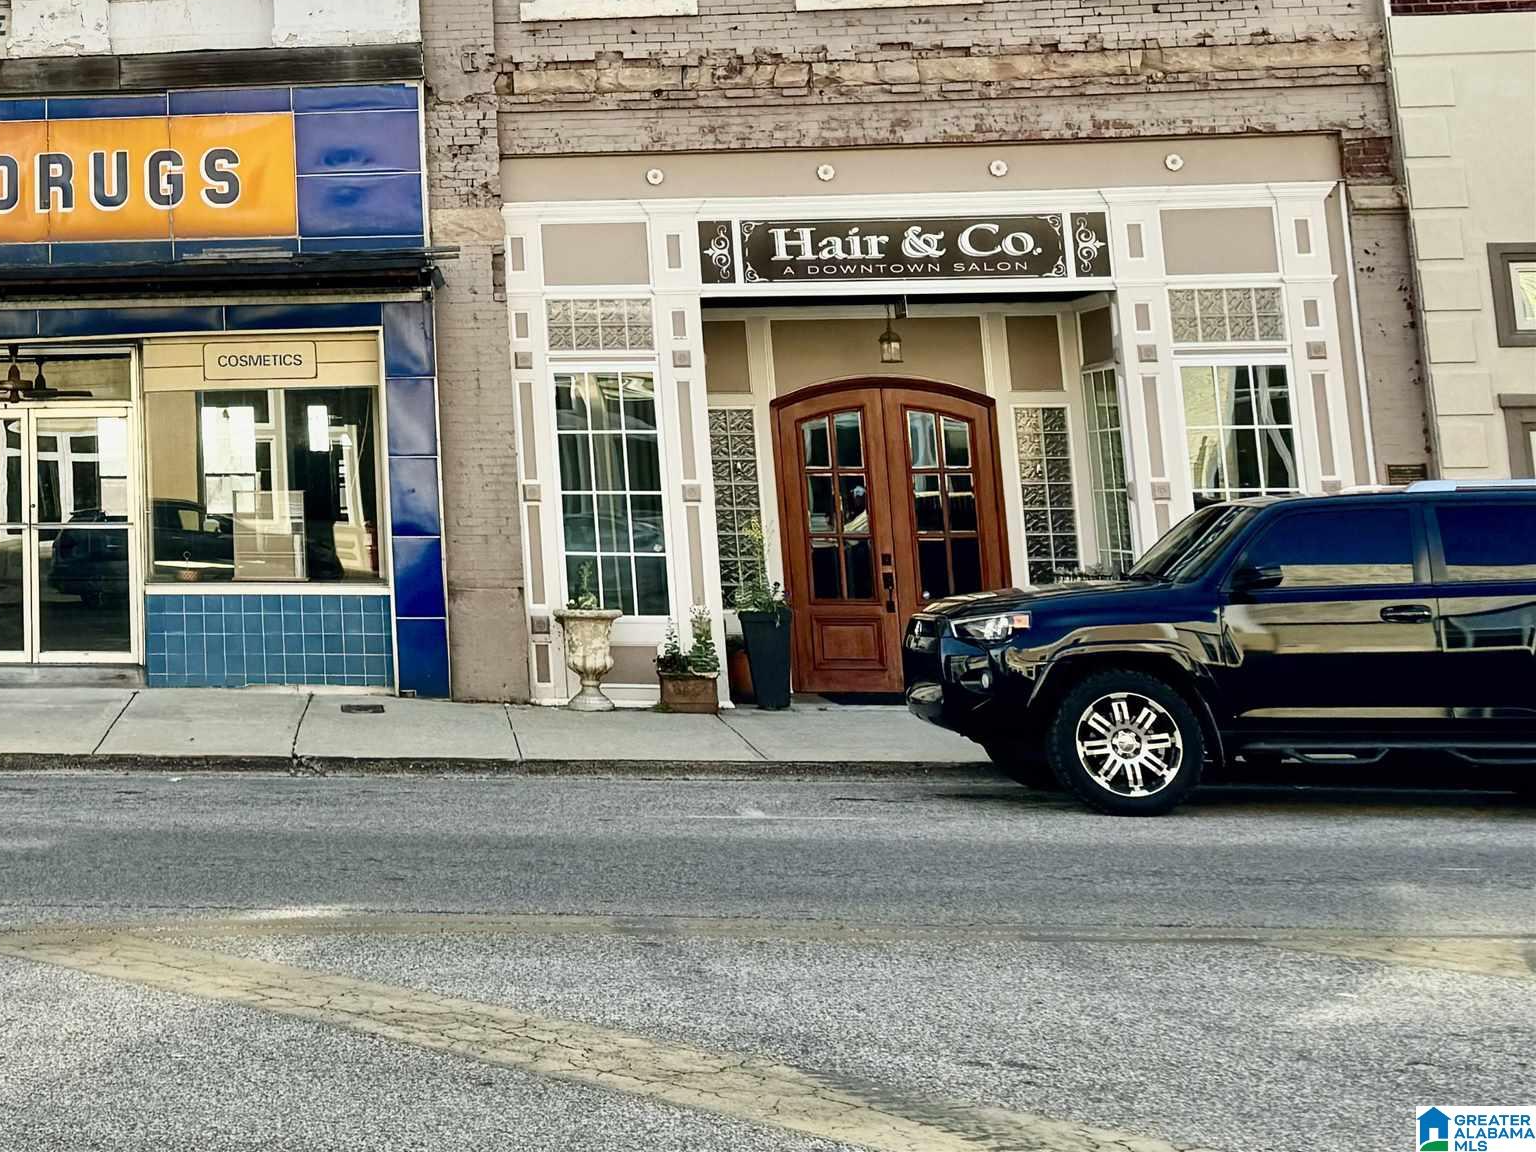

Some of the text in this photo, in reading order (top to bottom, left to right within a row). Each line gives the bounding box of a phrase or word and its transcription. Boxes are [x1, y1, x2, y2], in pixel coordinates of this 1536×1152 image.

[768, 223, 1043, 262] Hair & Co.
[783, 260, 1029, 276] A DOWNTOWN SALON
[217, 354, 303, 367] COSMETICS
